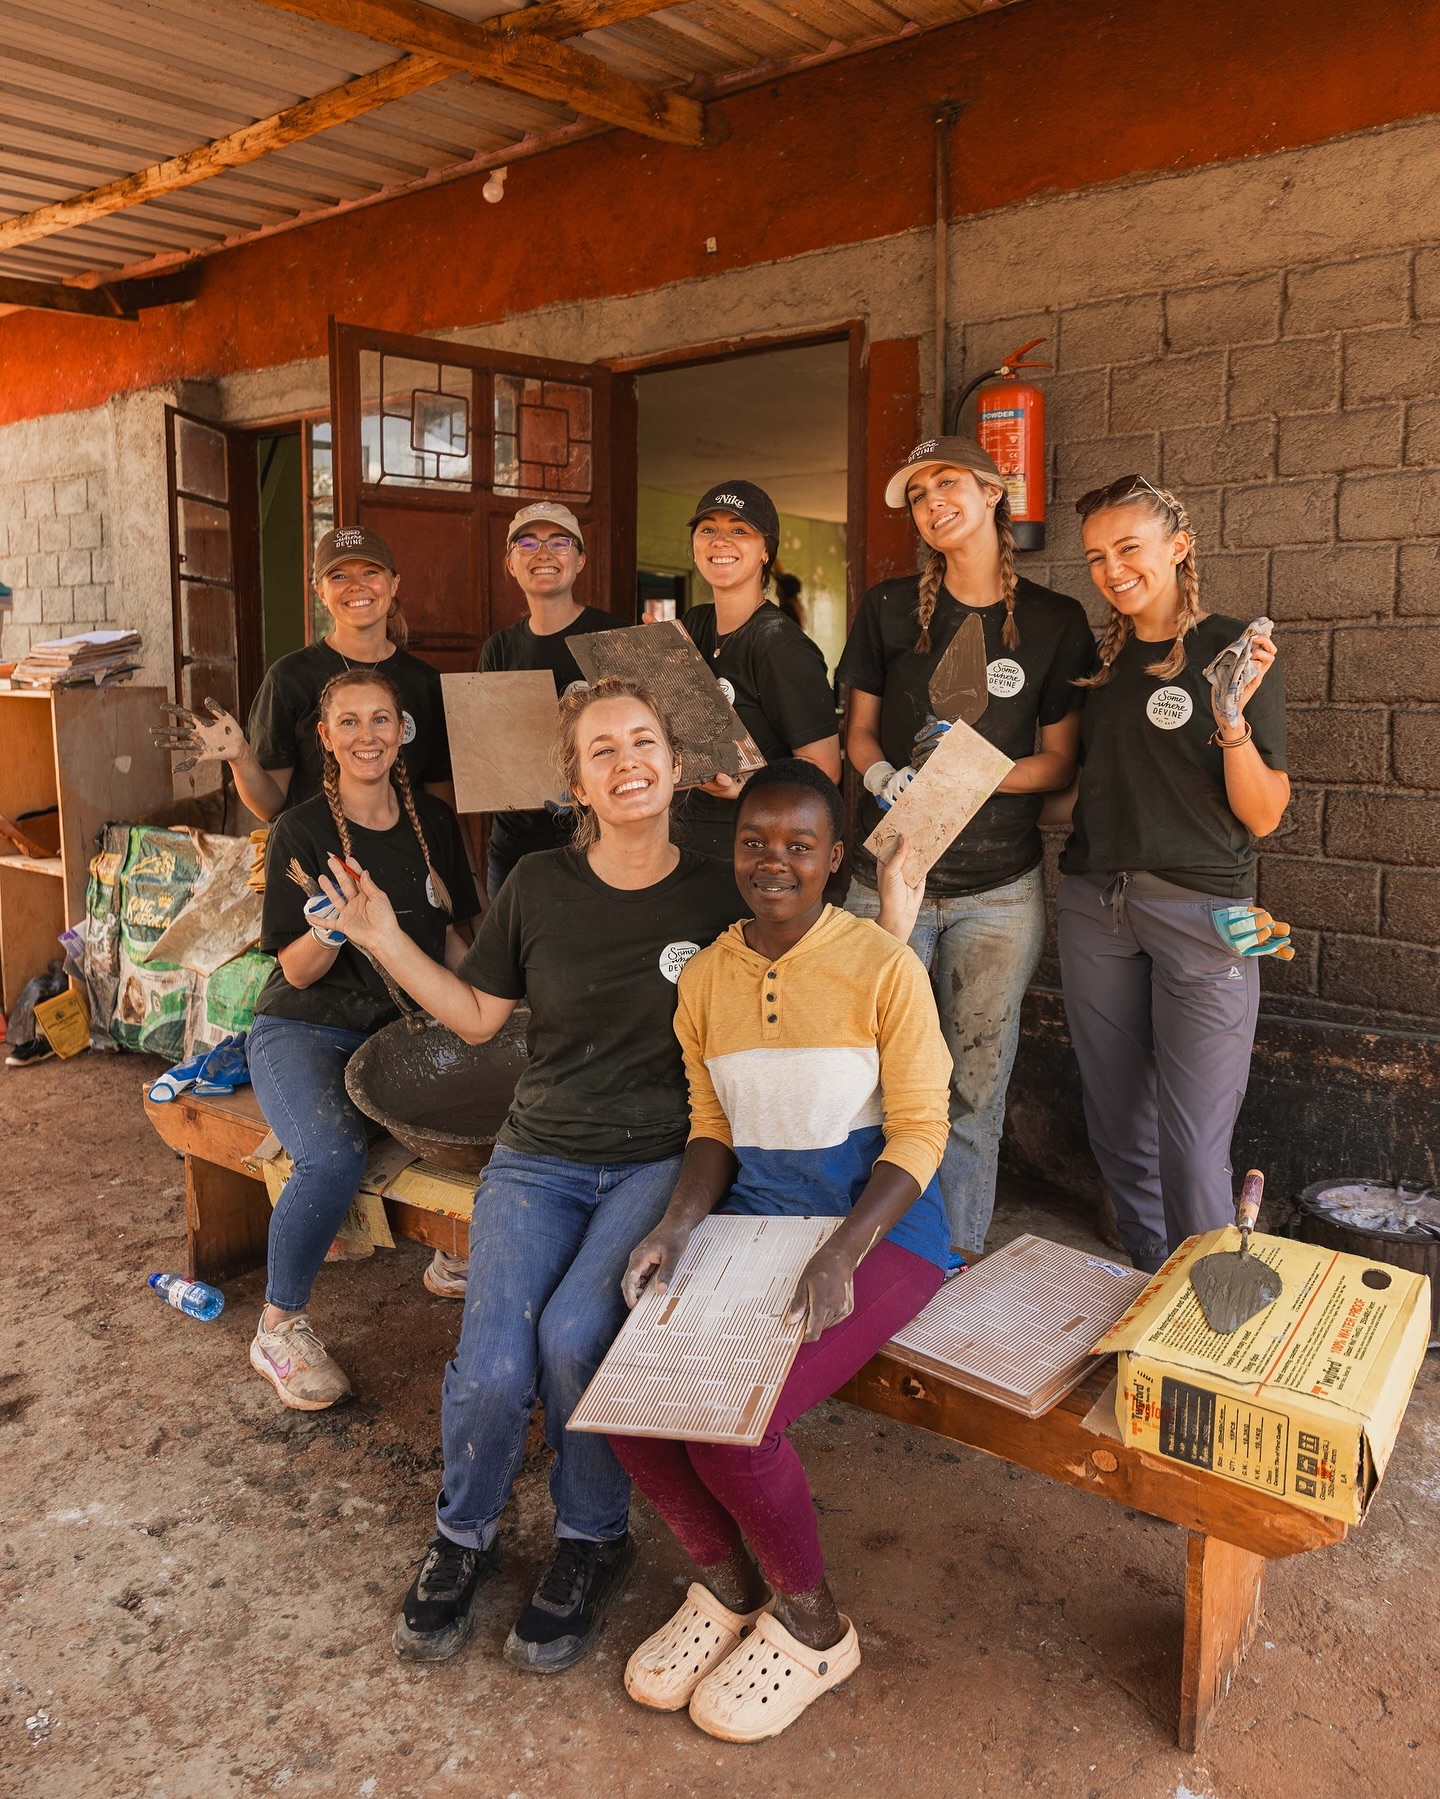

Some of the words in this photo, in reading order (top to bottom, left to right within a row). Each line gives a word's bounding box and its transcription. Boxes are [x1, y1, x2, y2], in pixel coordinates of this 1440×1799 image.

[983, 411, 1015, 420] POWDER
[715, 494, 745, 509] Nike
[336, 540, 363, 548] DEVINE
[993, 663, 1019, 674] Some
[988, 673, 1020, 682] where
[989, 678, 1016, 688] DEVINE
[1158, 690, 1186, 703] Some
[1152, 701, 1188, 712] where
[1153, 707, 1183, 719] DEVINE
[668, 947, 696, 960] Some
[1174, 1299, 1185, 1307] and
[1347, 1297, 1366, 1318] PROOF
[1155, 1307, 1180, 1331] Instructions
[1336, 1316, 1357, 1339] WATER
[1147, 1330, 1164, 1343] Tiling
[1239, 1329, 1252, 1340] need
[1235, 1340, 1247, 1350] may
[1327, 1337, 1347, 1355] 100%
[1230, 1349, 1241, 1357] you
[1222, 1355, 1235, 1367] Tools
[1240, 1360, 1256, 1374] Tiling
[1248, 1352, 1261, 1362] tips
[1314, 1359, 1346, 1388] Twyford
[1131, 1381, 1145, 1421] Twyford
[1275, 1422, 1283, 1440] Quality
